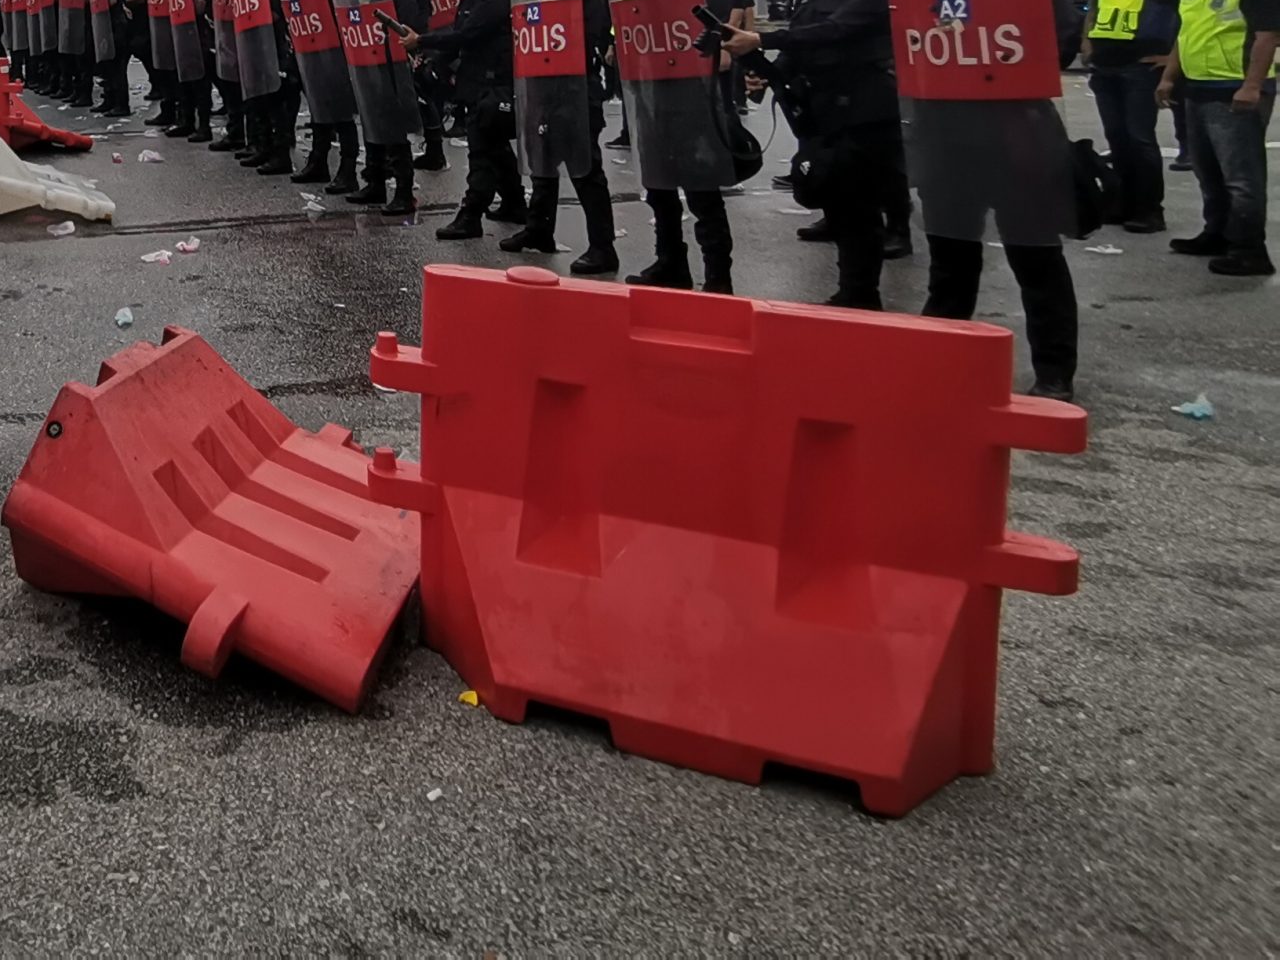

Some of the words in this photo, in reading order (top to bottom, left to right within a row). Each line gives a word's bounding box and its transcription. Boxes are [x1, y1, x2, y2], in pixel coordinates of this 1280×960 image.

[349, 9, 361, 21] A2
[526, 6, 540, 22] A2
[939, 0, 968, 19] A2
[622, 20, 692, 55] POLIS
[905, 24, 1024, 66] POLIS
